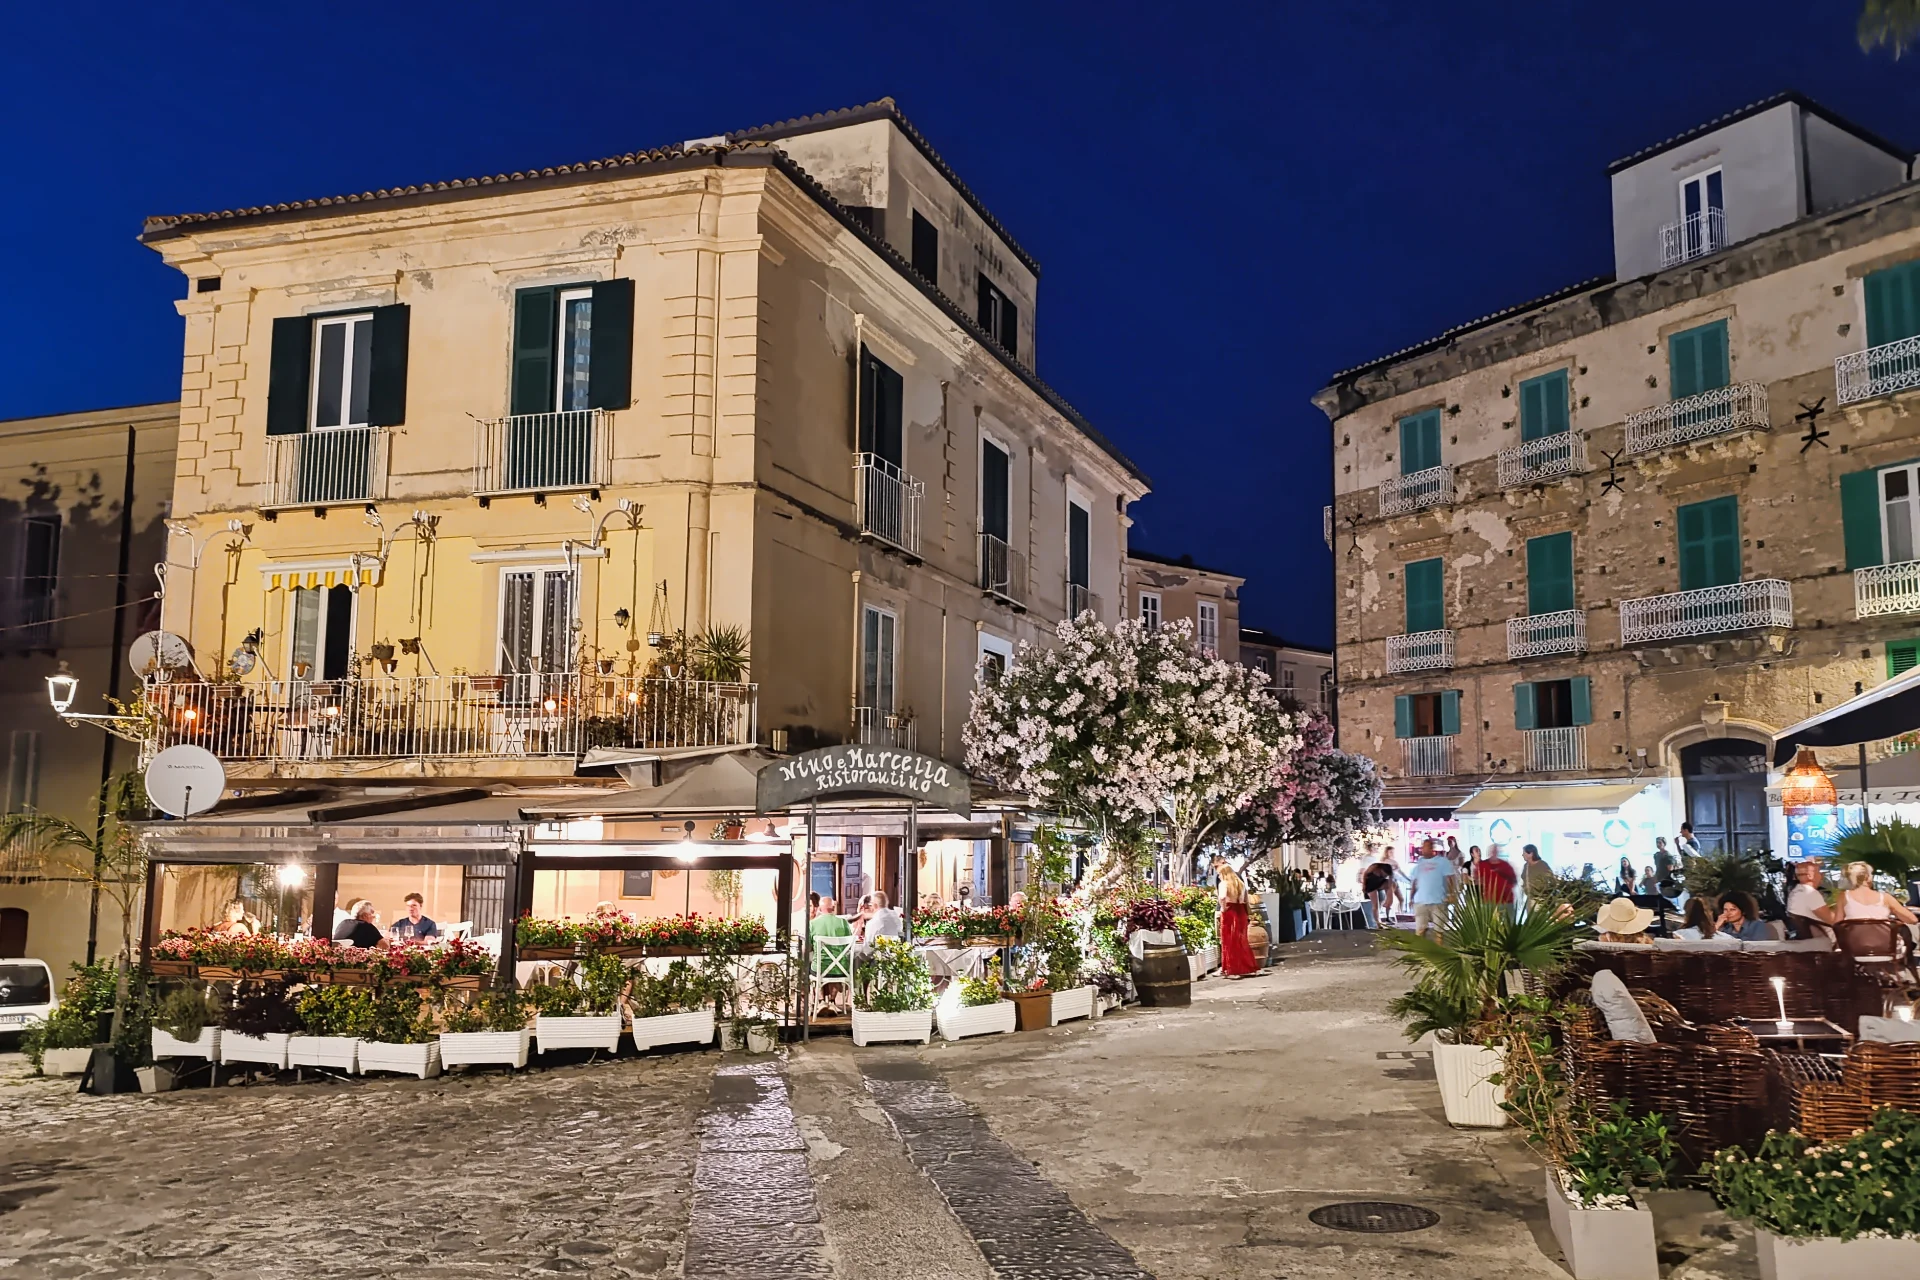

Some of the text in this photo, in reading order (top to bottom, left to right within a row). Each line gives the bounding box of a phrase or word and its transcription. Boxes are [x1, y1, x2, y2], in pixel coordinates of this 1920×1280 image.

[779, 748, 950, 788] Nino e Marcella
[816, 767, 932, 793] Ristorantino
